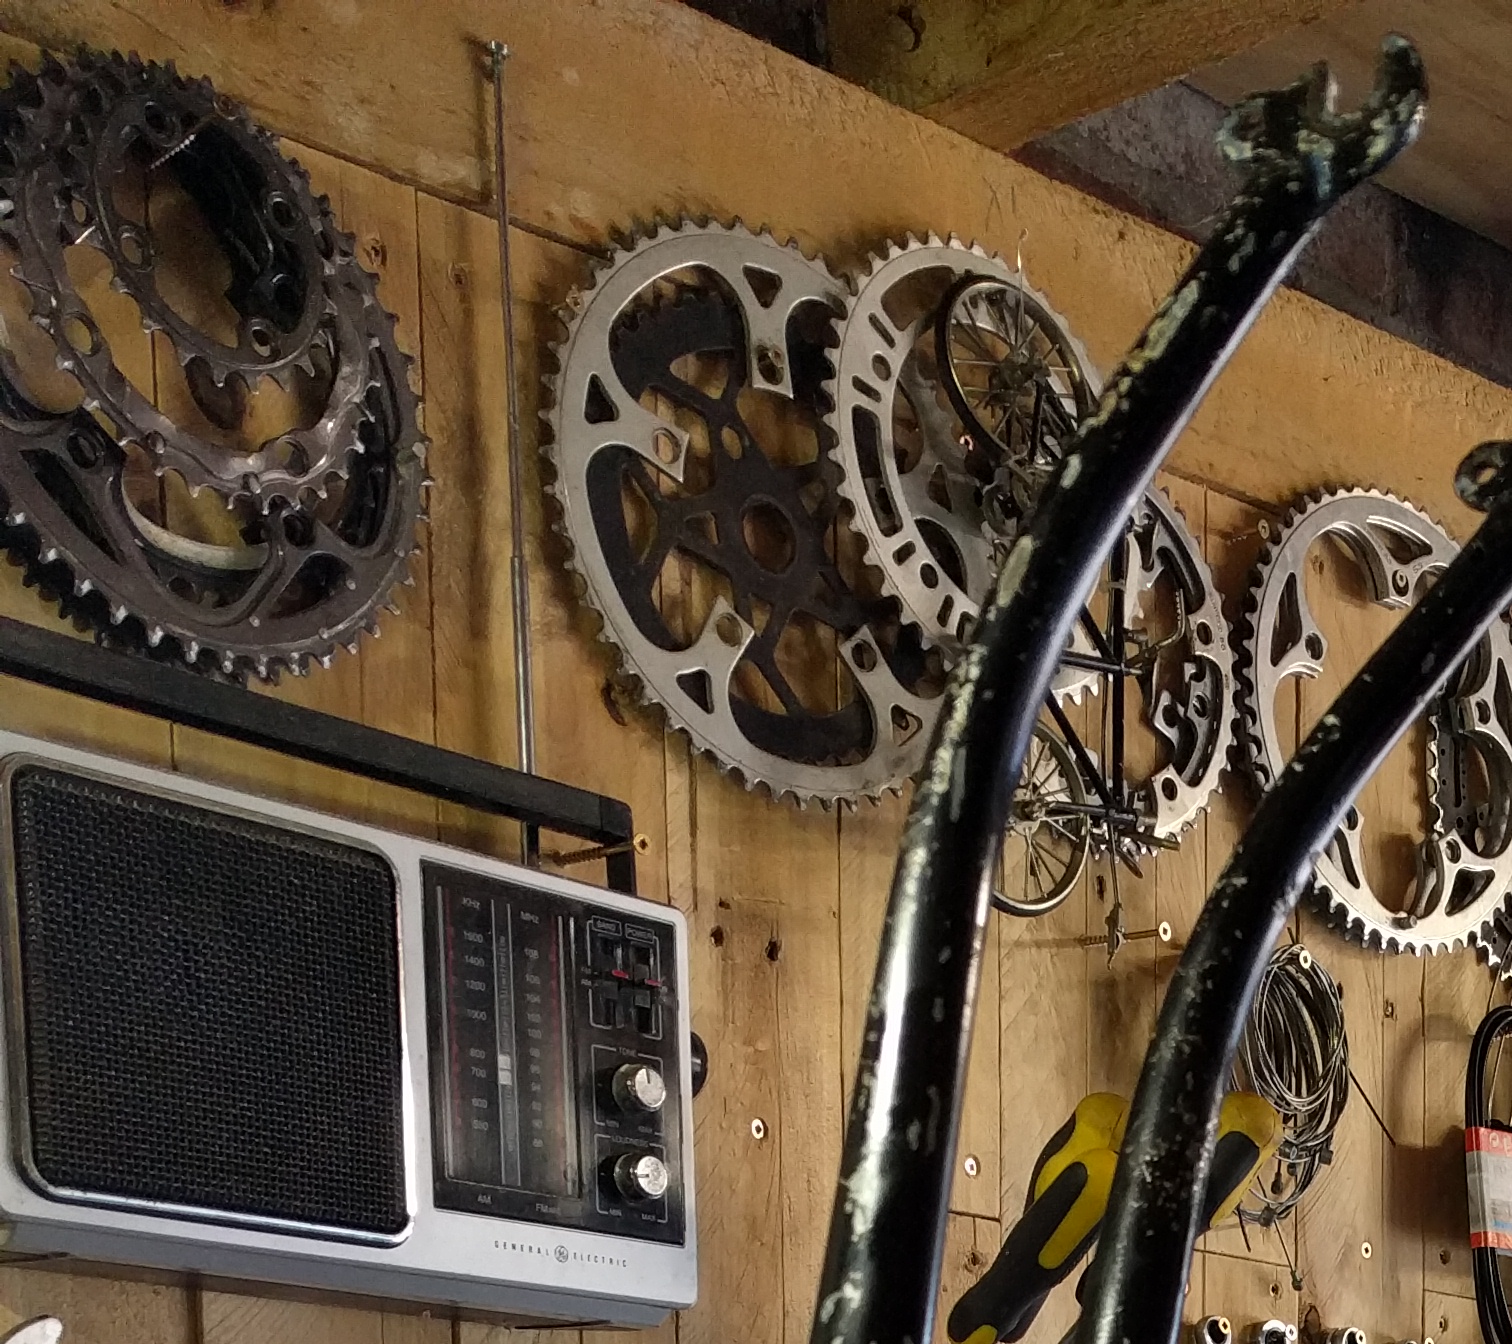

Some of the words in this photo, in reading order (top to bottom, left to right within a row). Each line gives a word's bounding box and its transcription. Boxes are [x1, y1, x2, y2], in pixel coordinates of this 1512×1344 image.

[464, 955, 485, 967] 1400
[470, 1067, 487, 1078] 700
[477, 1193, 492, 1205] AM
[494, 1239, 550, 1257] GENERAL
[573, 1252, 628, 1268] ELECTRIC
